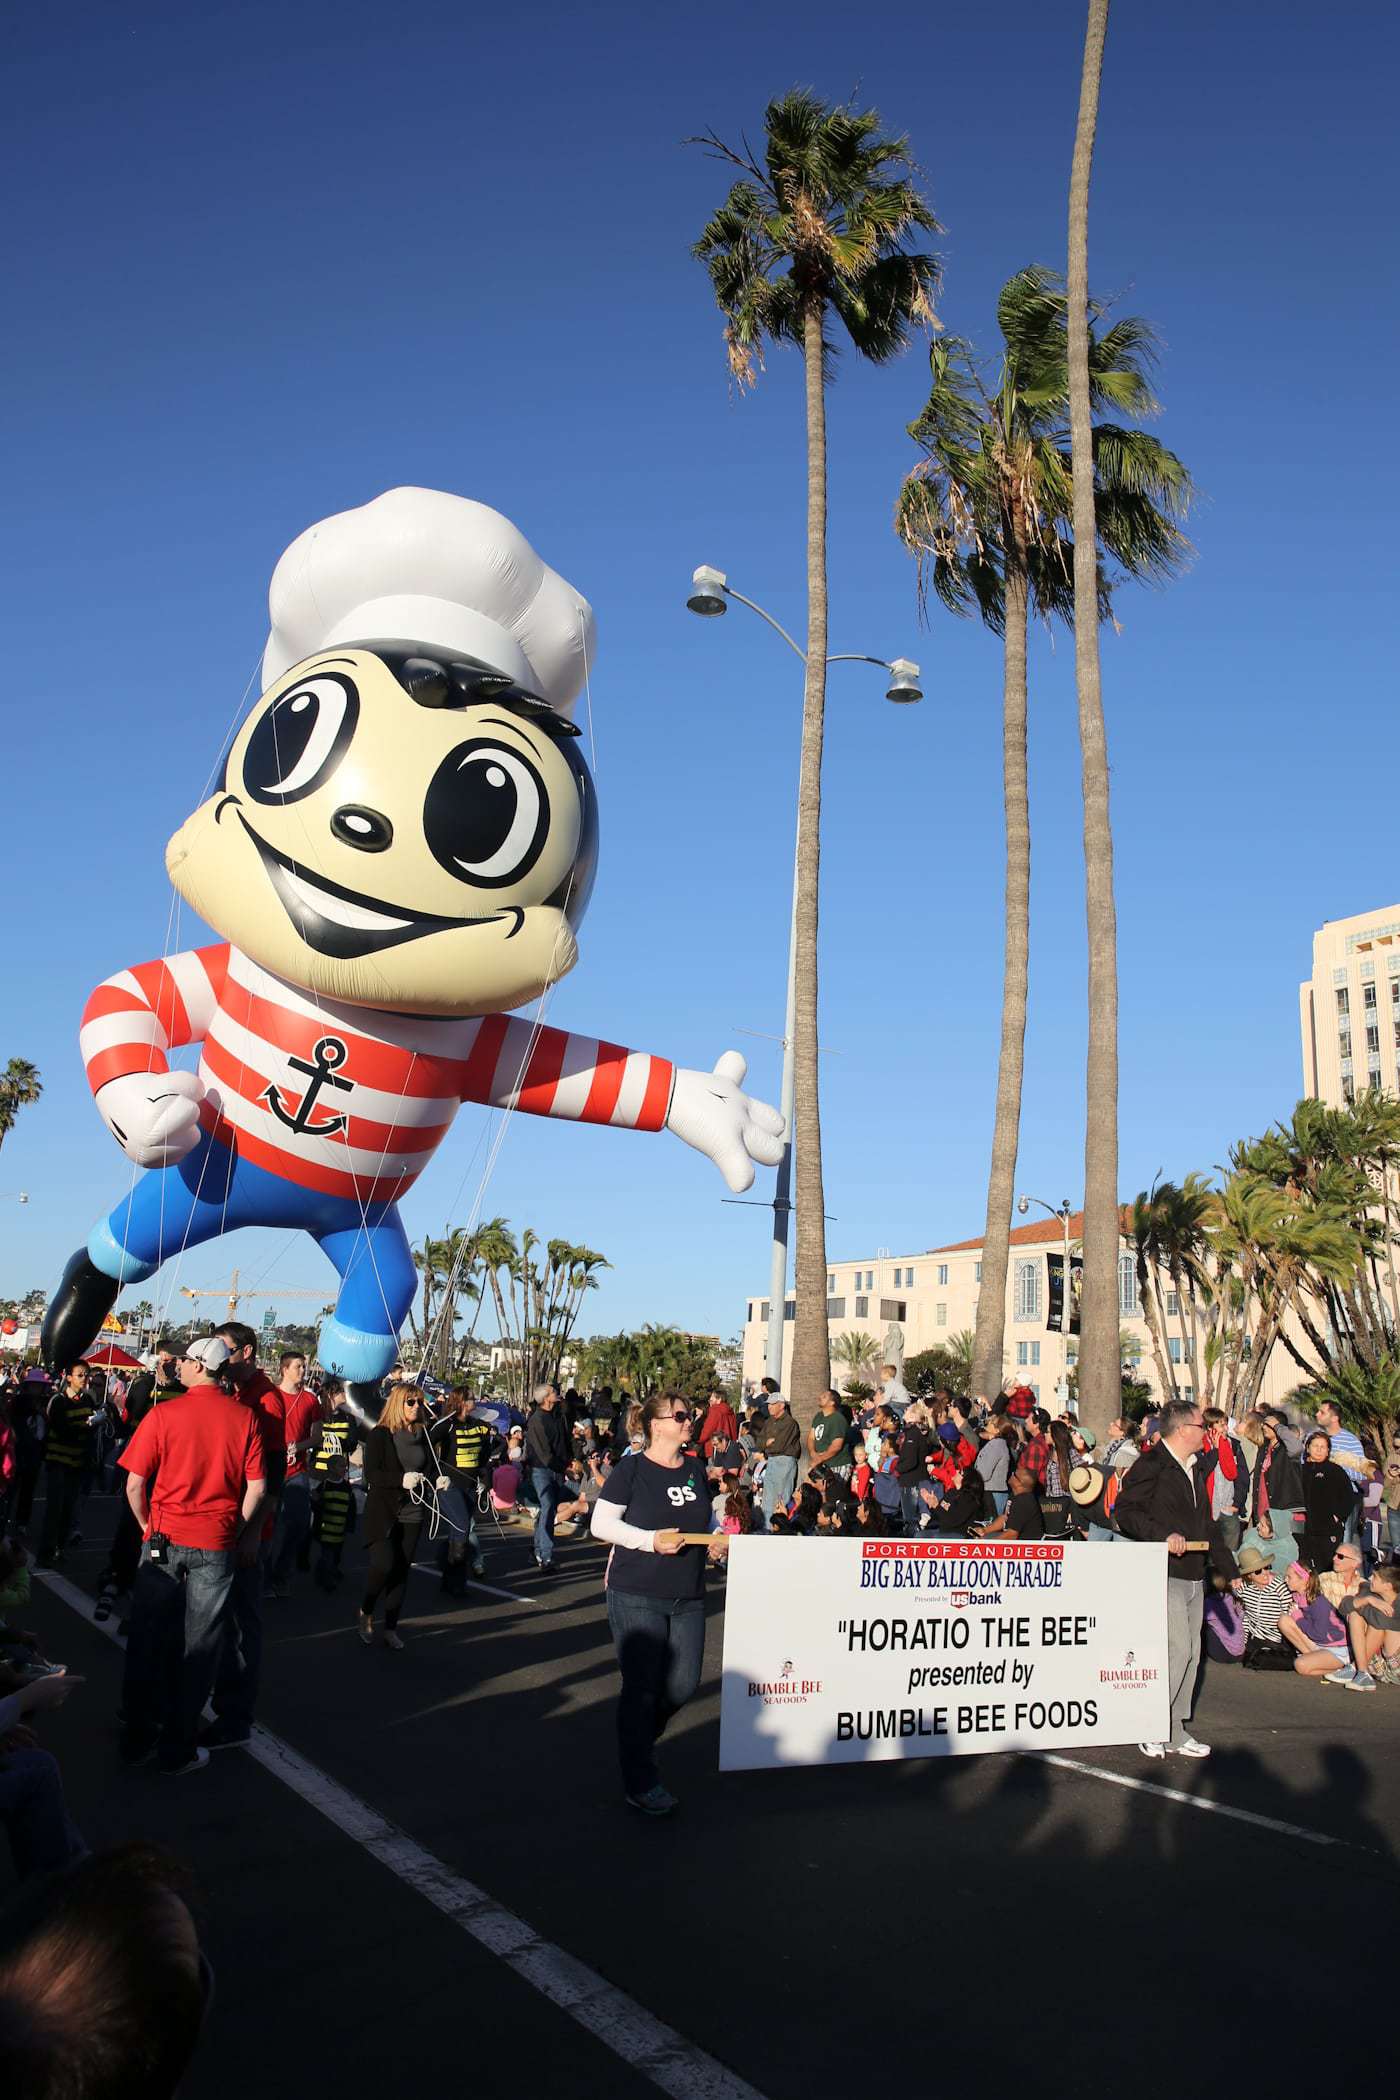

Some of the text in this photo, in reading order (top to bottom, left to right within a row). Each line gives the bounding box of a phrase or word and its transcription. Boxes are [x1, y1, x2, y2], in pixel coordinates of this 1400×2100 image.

[865, 1544, 1062, 1558] PORT OF SAN DIEGO
[860, 1559, 1062, 1588] BIG BAY BALLOON PARADE
[914, 1595, 942, 1603] Presented
[838, 1616, 1096, 1652] "HORATIO THE BEE"
[908, 1659, 1034, 1694] presented by
[1100, 1668, 1159, 1682] BUMBLE BEE
[748, 1680, 823, 1697] BUMBLE BEE
[1112, 1682, 1148, 1690] SEAFOODS
[763, 1695, 807, 1705] SEAFOODS
[836, 1700, 1098, 1742] BUMBLE BEE FOODS
